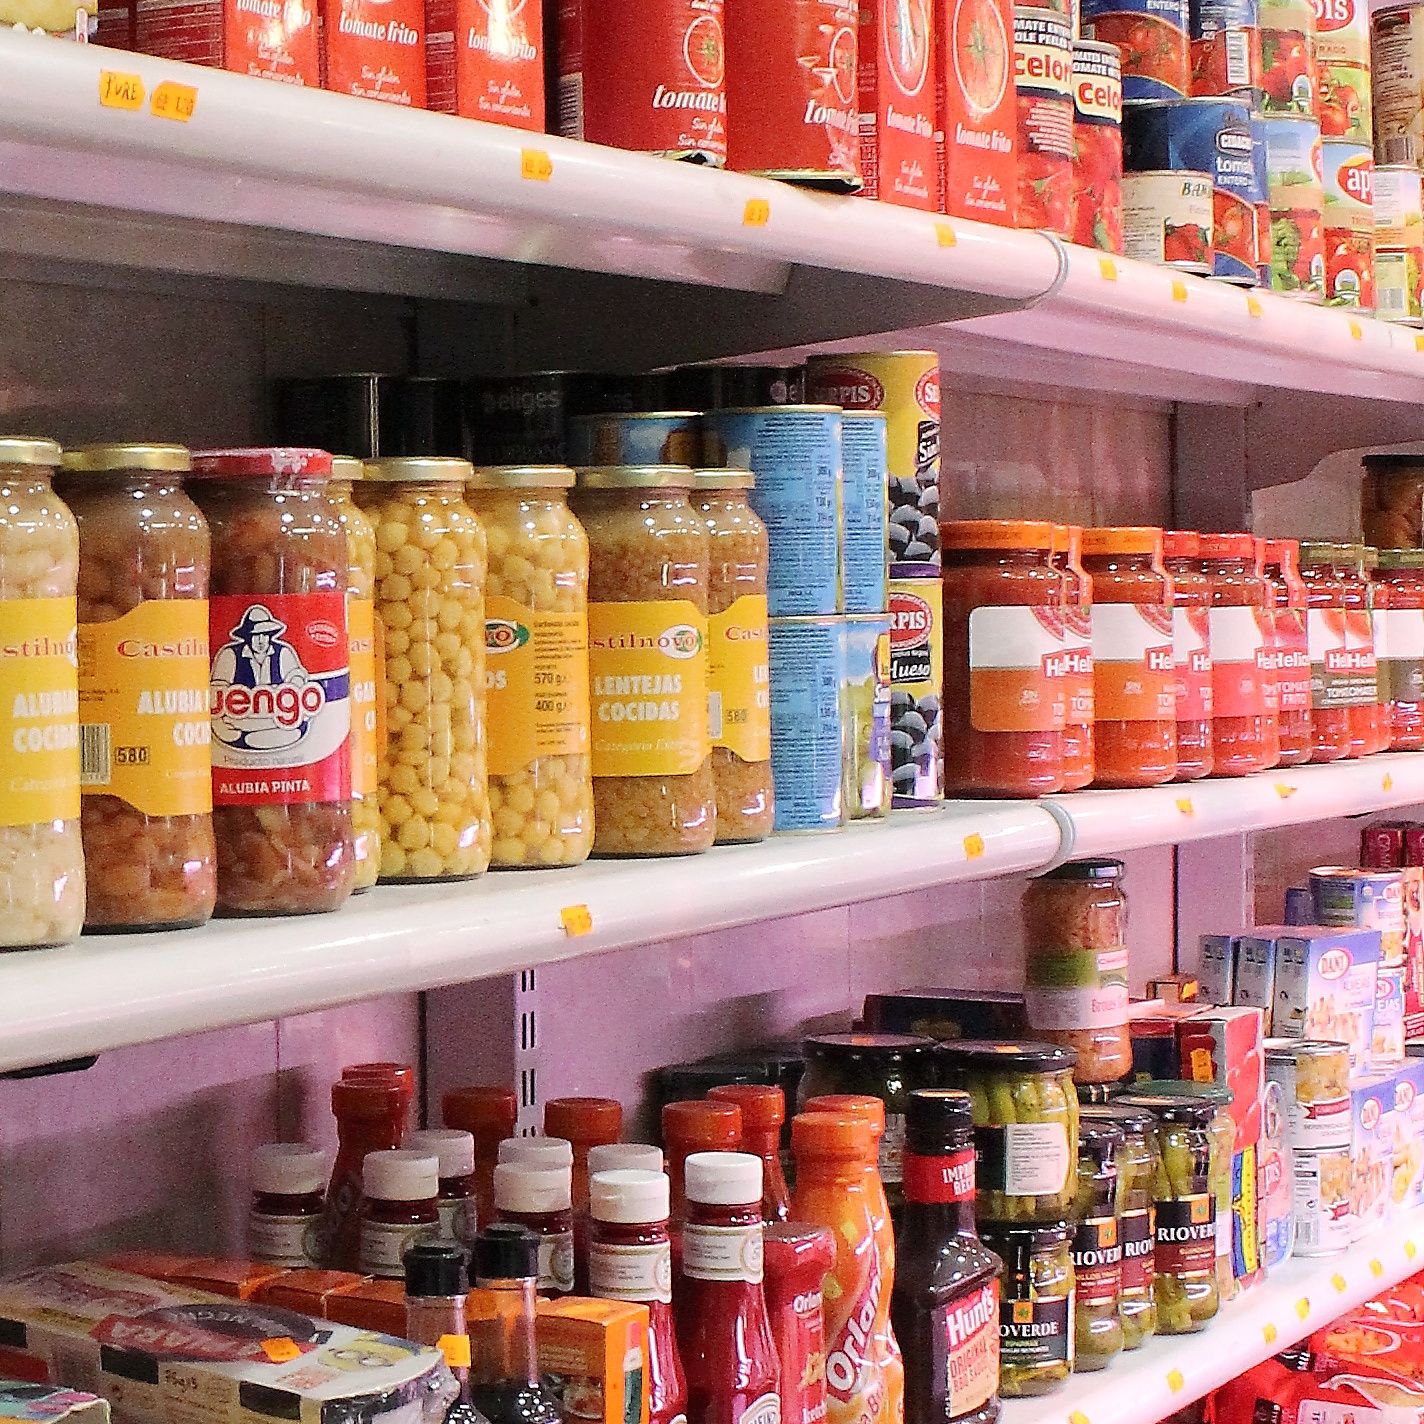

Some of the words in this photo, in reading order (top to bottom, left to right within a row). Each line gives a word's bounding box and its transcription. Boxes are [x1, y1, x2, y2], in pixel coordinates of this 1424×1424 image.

[339, 9, 386, 41] tomate
[389, 19, 418, 46] frito
[652, 84, 722, 112] tomate
[956, 125, 992, 152] tomate
[994, 130, 1012, 154] frito
[594, 675, 682, 696] LENTEJAS
[598, 702, 679, 722] COCIDAS
[116, 748, 147, 763] 580
[220, 782, 268, 795] ALUBIA
[272, 780, 310, 794] PINTA
[947, 1285, 996, 1343] Hunt's
